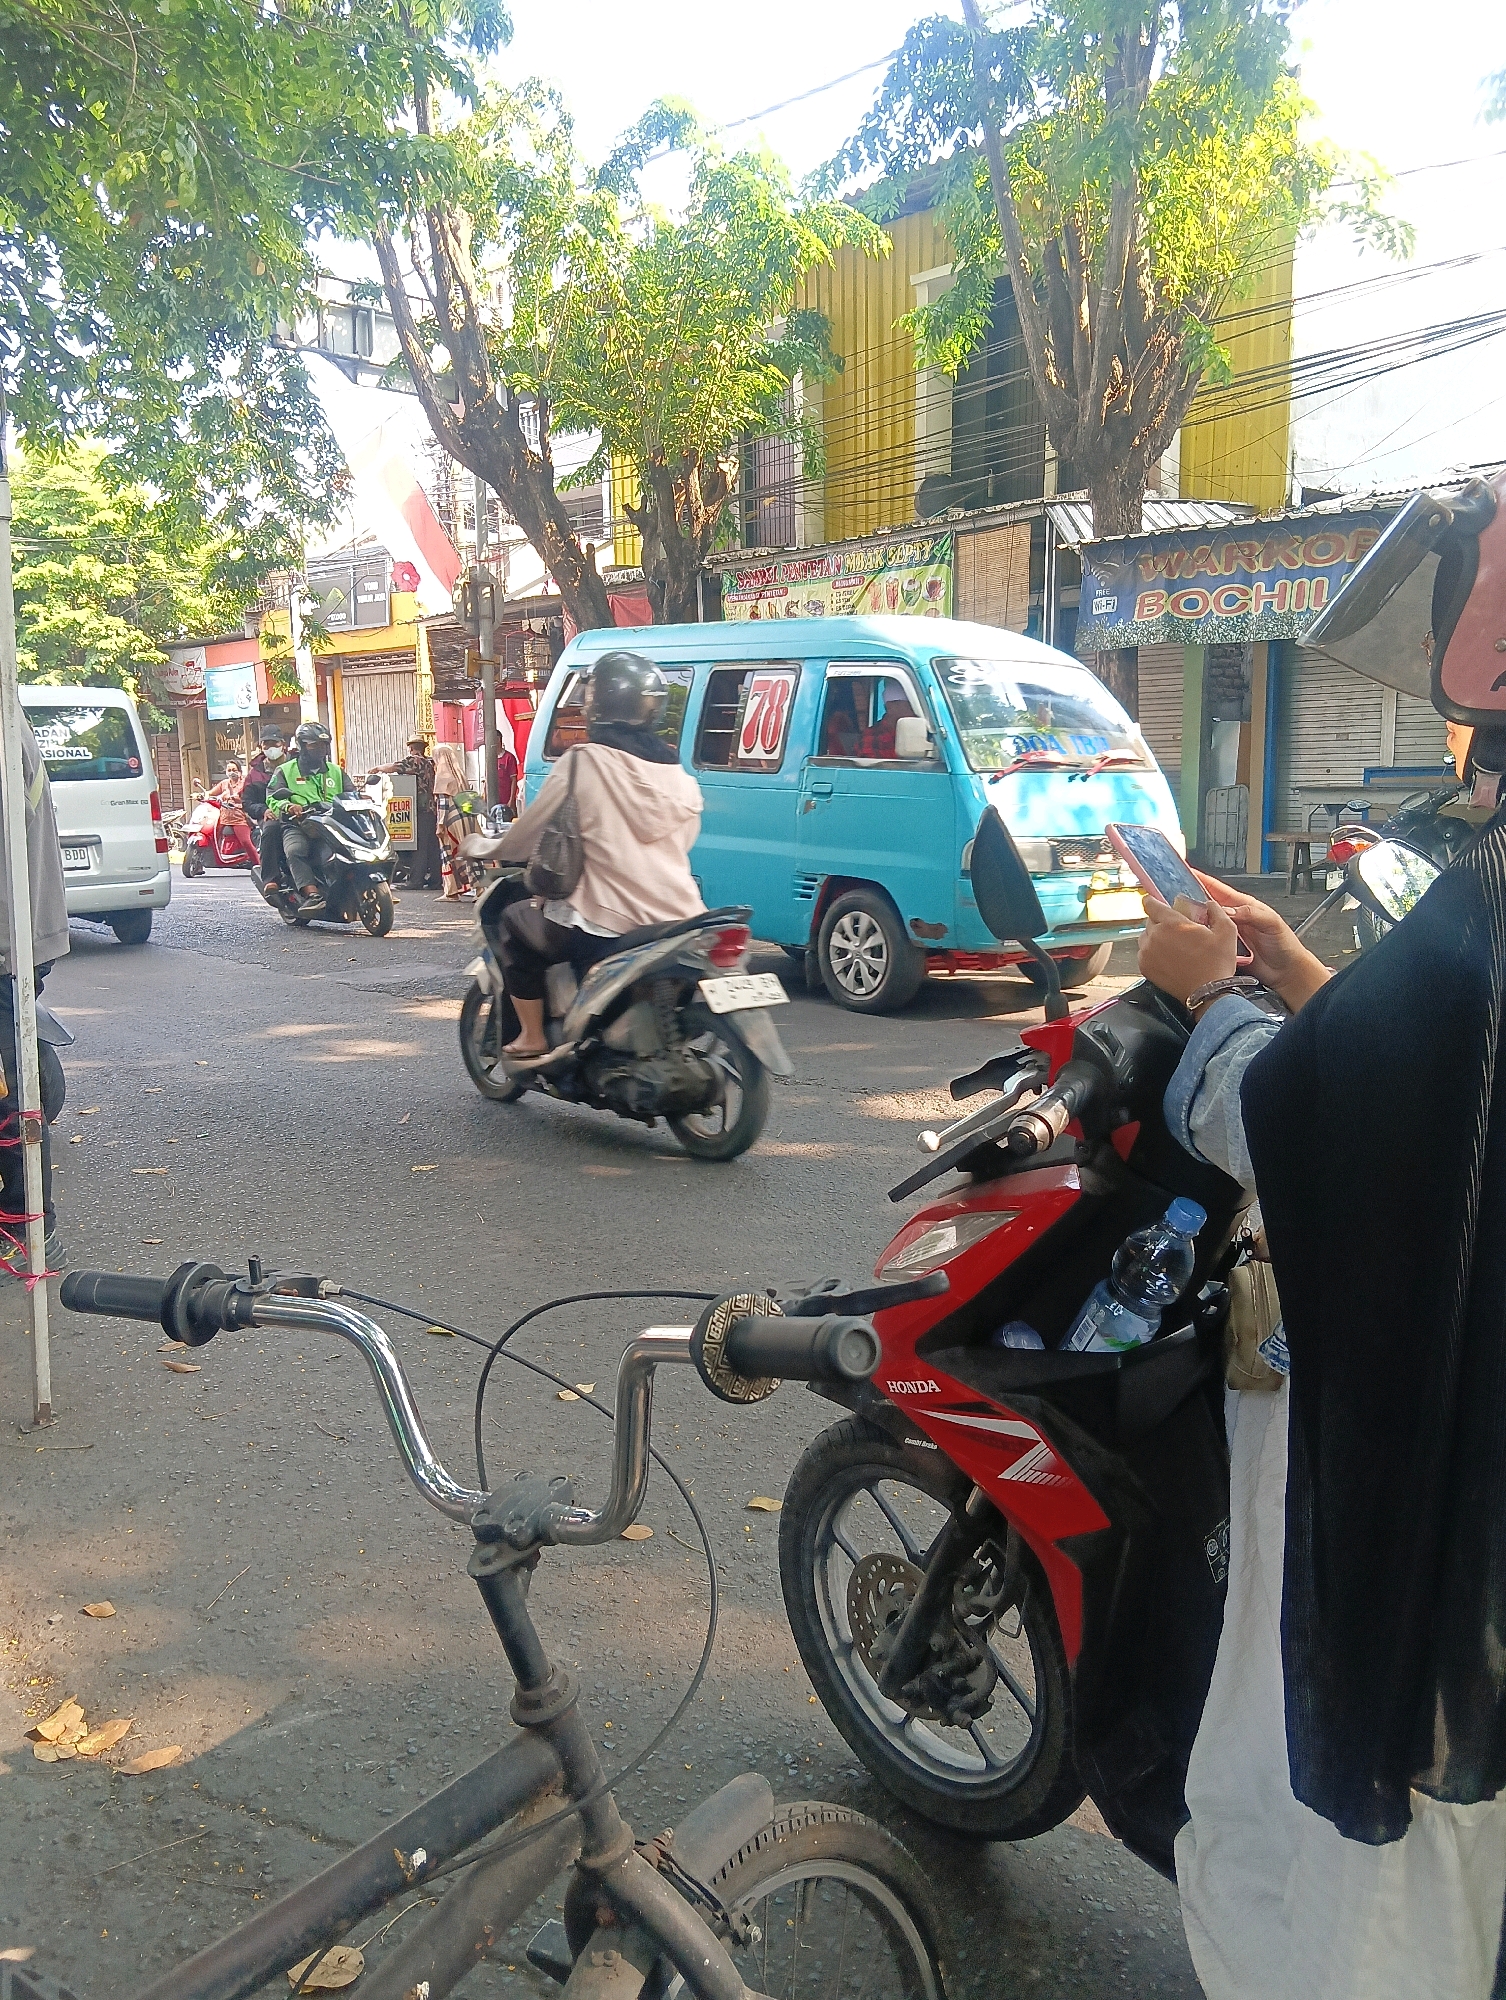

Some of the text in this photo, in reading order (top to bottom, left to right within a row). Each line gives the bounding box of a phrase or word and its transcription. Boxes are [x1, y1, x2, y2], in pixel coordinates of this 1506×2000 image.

[1138, 527, 1381, 583] WARKOP
[780, 555, 843, 584] PENYETAN
[844, 547, 885, 575] MBAK
[1095, 588, 1111, 597] FREE
[1134, 572, 1351, 622] BOCHIL
[742, 679, 791, 754] 78
[34, 729, 68, 738] ADAN
[39, 749, 90, 758] ASIONAL
[388, 800, 411, 812] TELOR
[389, 811, 411, 823] ASIN
[886, 1379, 942, 1395] HONDA
